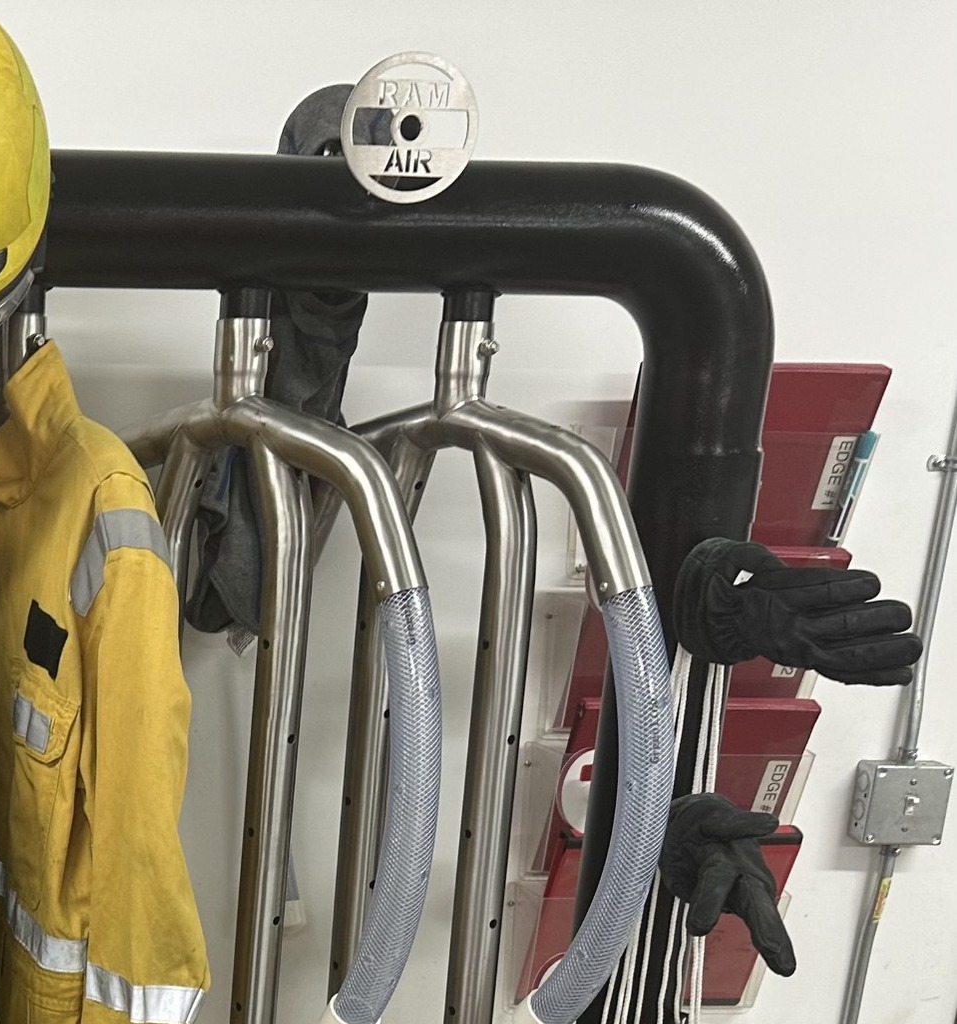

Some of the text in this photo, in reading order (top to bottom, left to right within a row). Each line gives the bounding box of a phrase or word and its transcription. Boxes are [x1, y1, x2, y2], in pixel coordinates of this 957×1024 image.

[378, 80, 451, 108] RAM
[383, 149, 432, 174] AIR
[827, 440, 854, 486] EDGE
[820, 489, 836, 506] #1
[762, 763, 789, 802] EDGE
